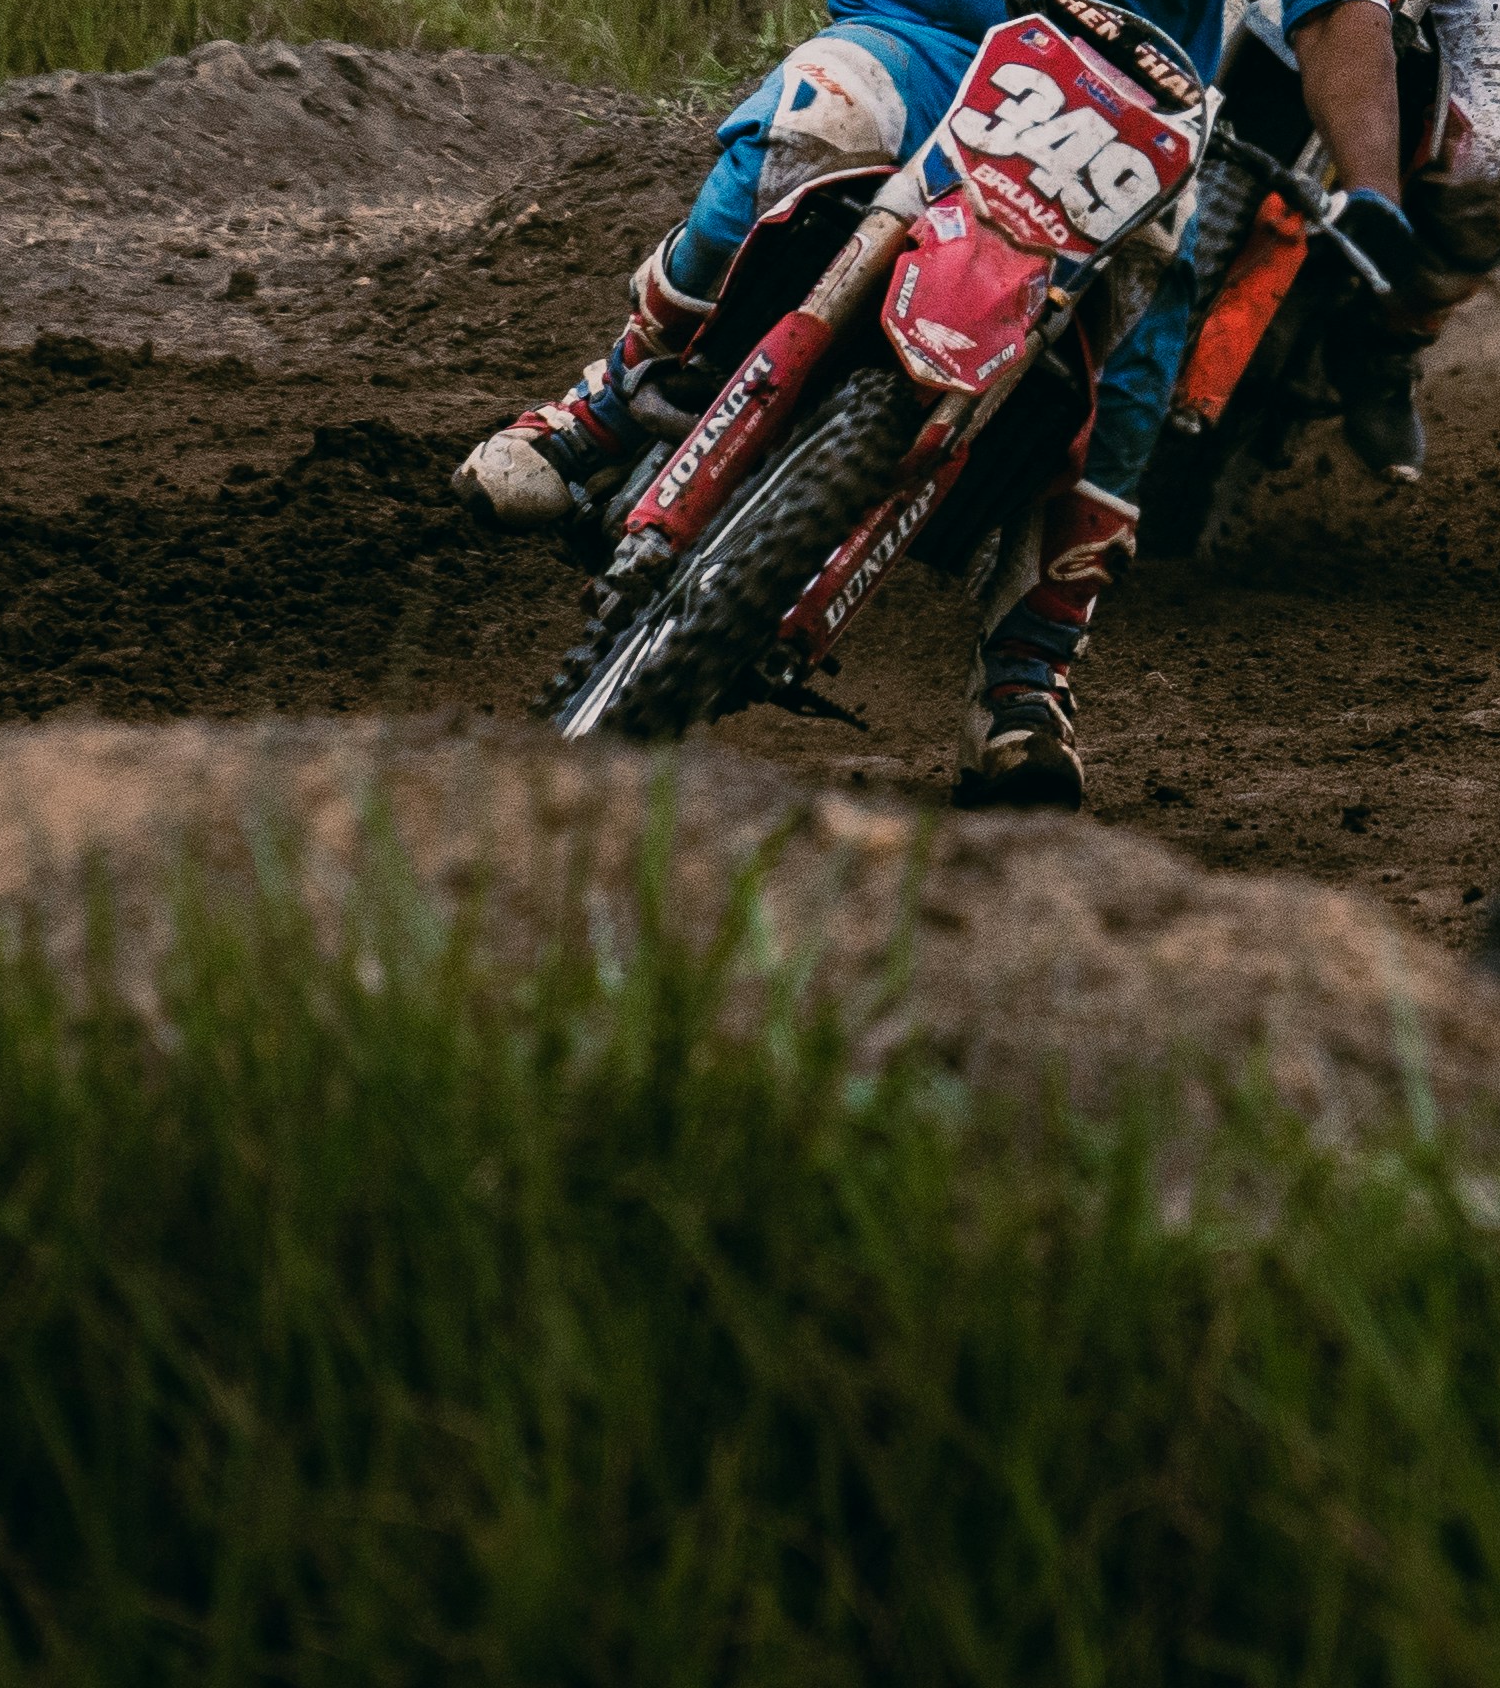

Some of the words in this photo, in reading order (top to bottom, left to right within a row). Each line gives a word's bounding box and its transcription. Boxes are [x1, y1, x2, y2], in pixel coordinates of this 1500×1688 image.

[949, 62, 1162, 243] 349
[975, 342, 1017, 382] DUNOP
[824, 480, 937, 634] DUNLOP
